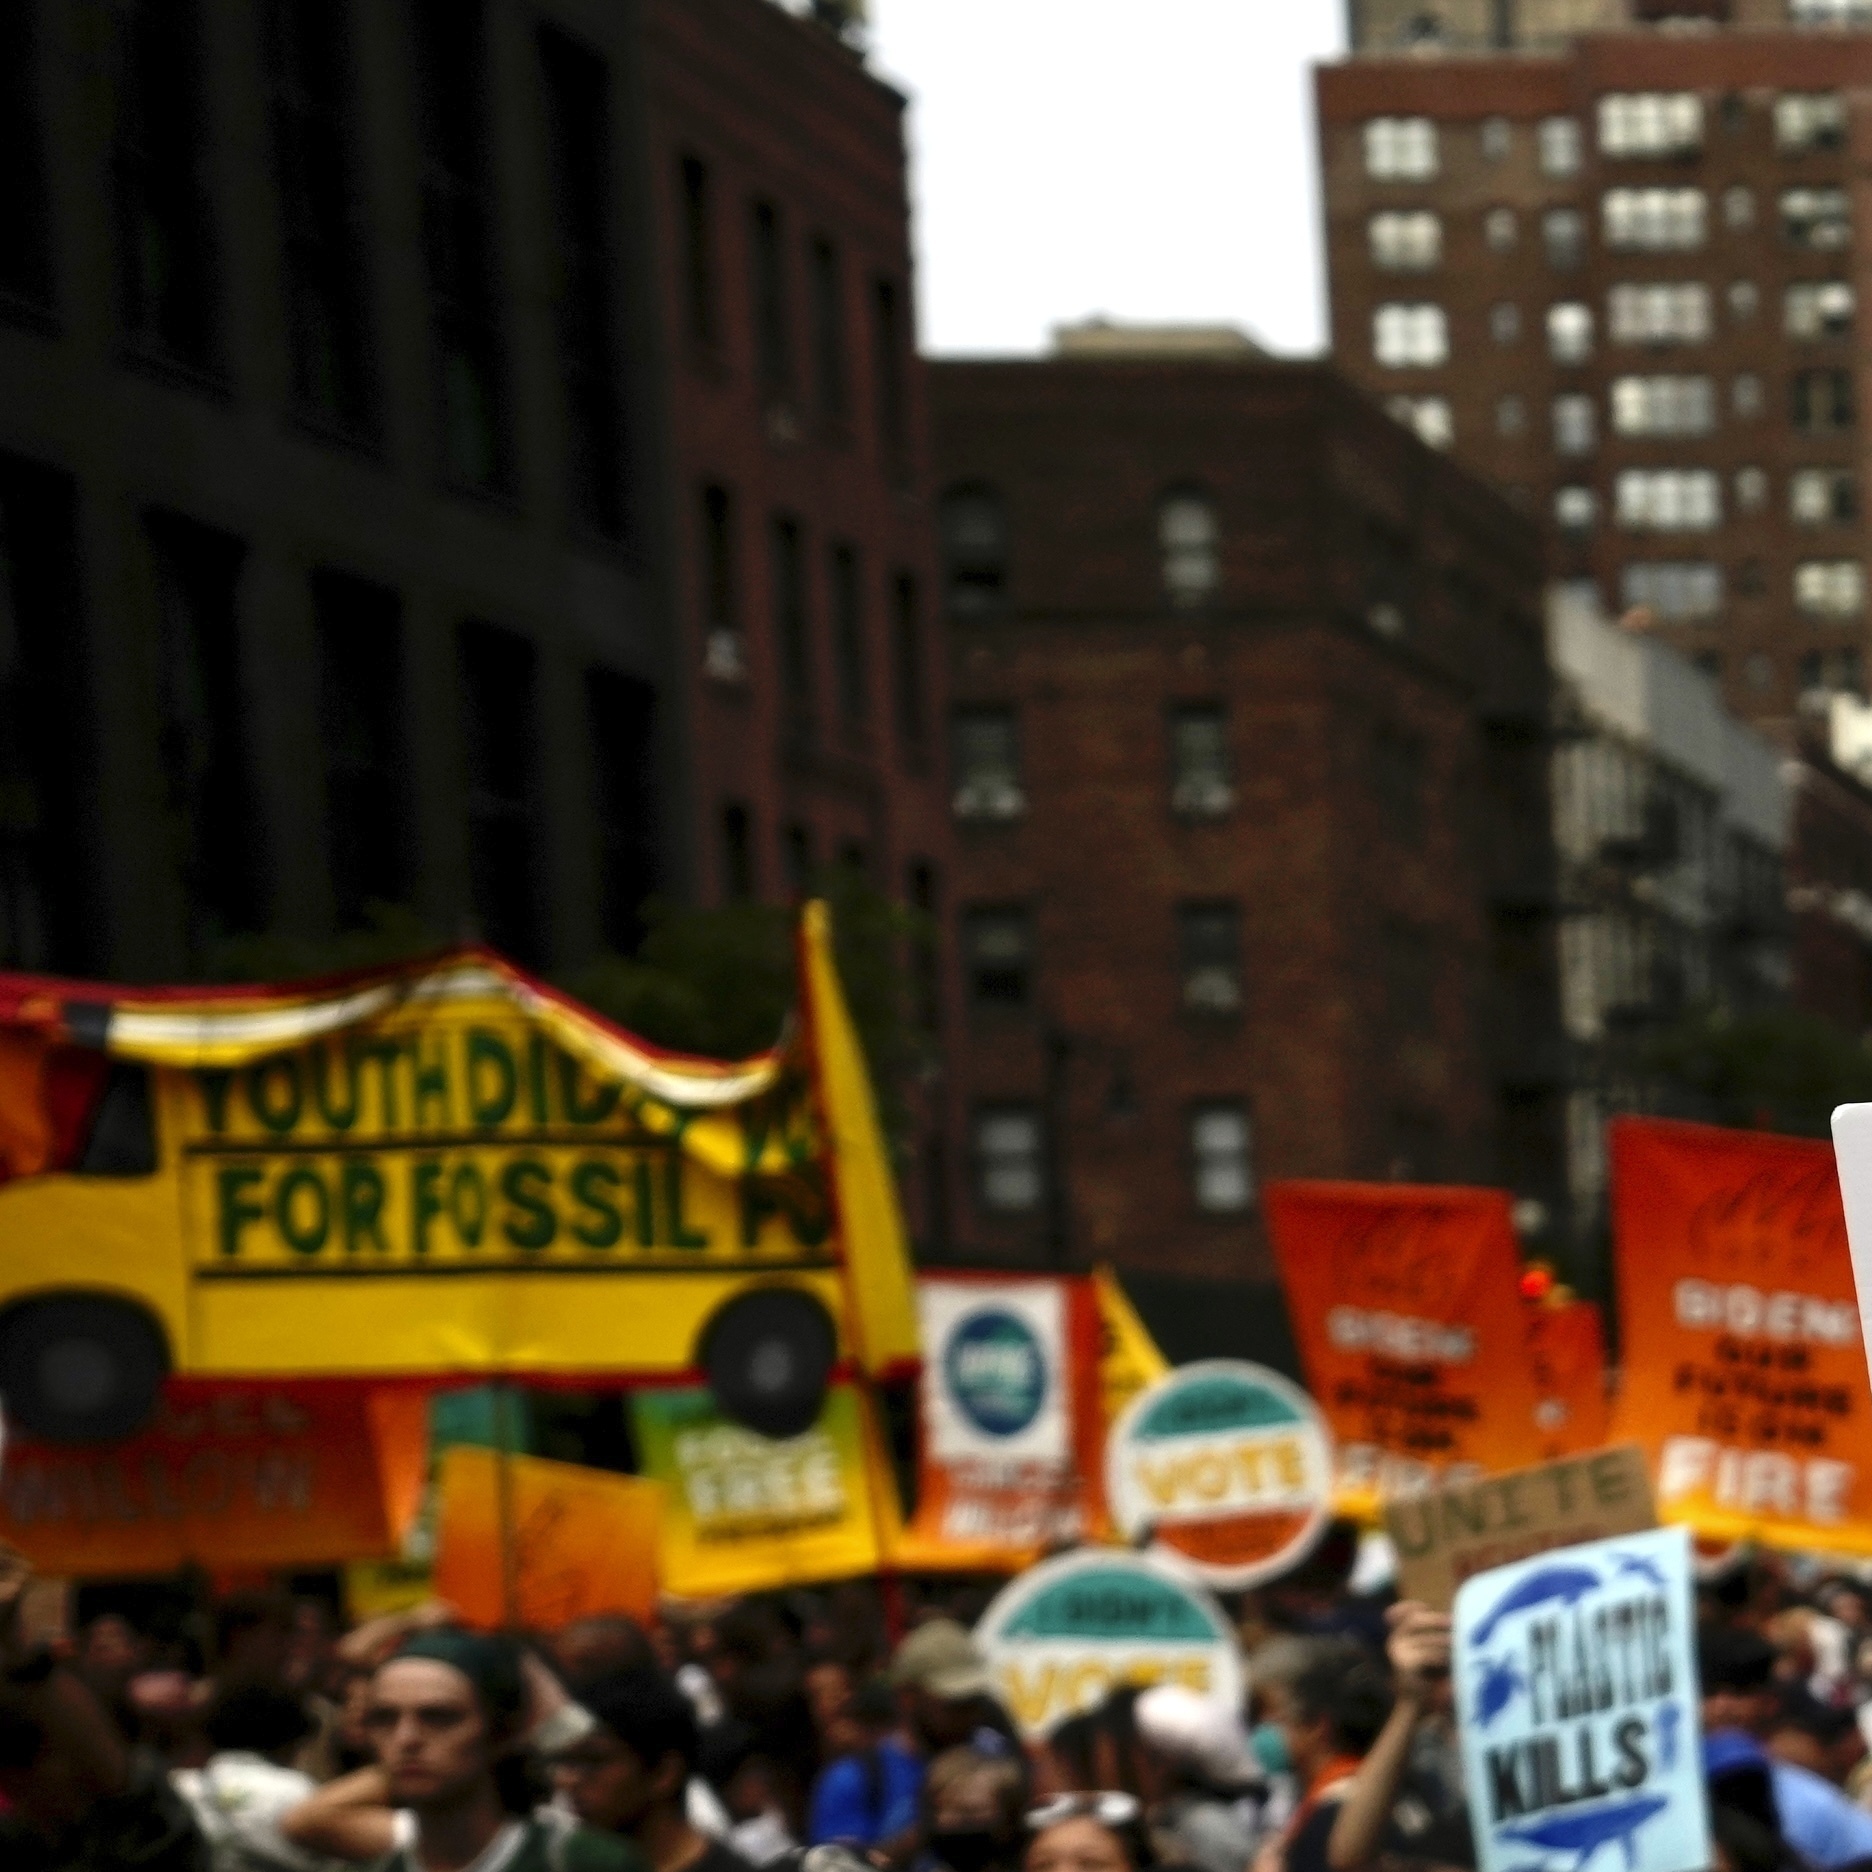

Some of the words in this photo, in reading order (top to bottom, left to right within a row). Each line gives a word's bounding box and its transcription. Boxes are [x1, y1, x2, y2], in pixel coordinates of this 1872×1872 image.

[219, 1160, 390, 1255] FOR
[411, 1158, 707, 1252] FOSSIL
[1136, 1437, 1305, 1507] VOTE
[1388, 1456, 1633, 1556] UNITE
[1659, 1436, 1853, 1525] FIRE
[1529, 1598, 1674, 1726] PLASTIC
[1485, 1717, 1648, 1823] KILLS
